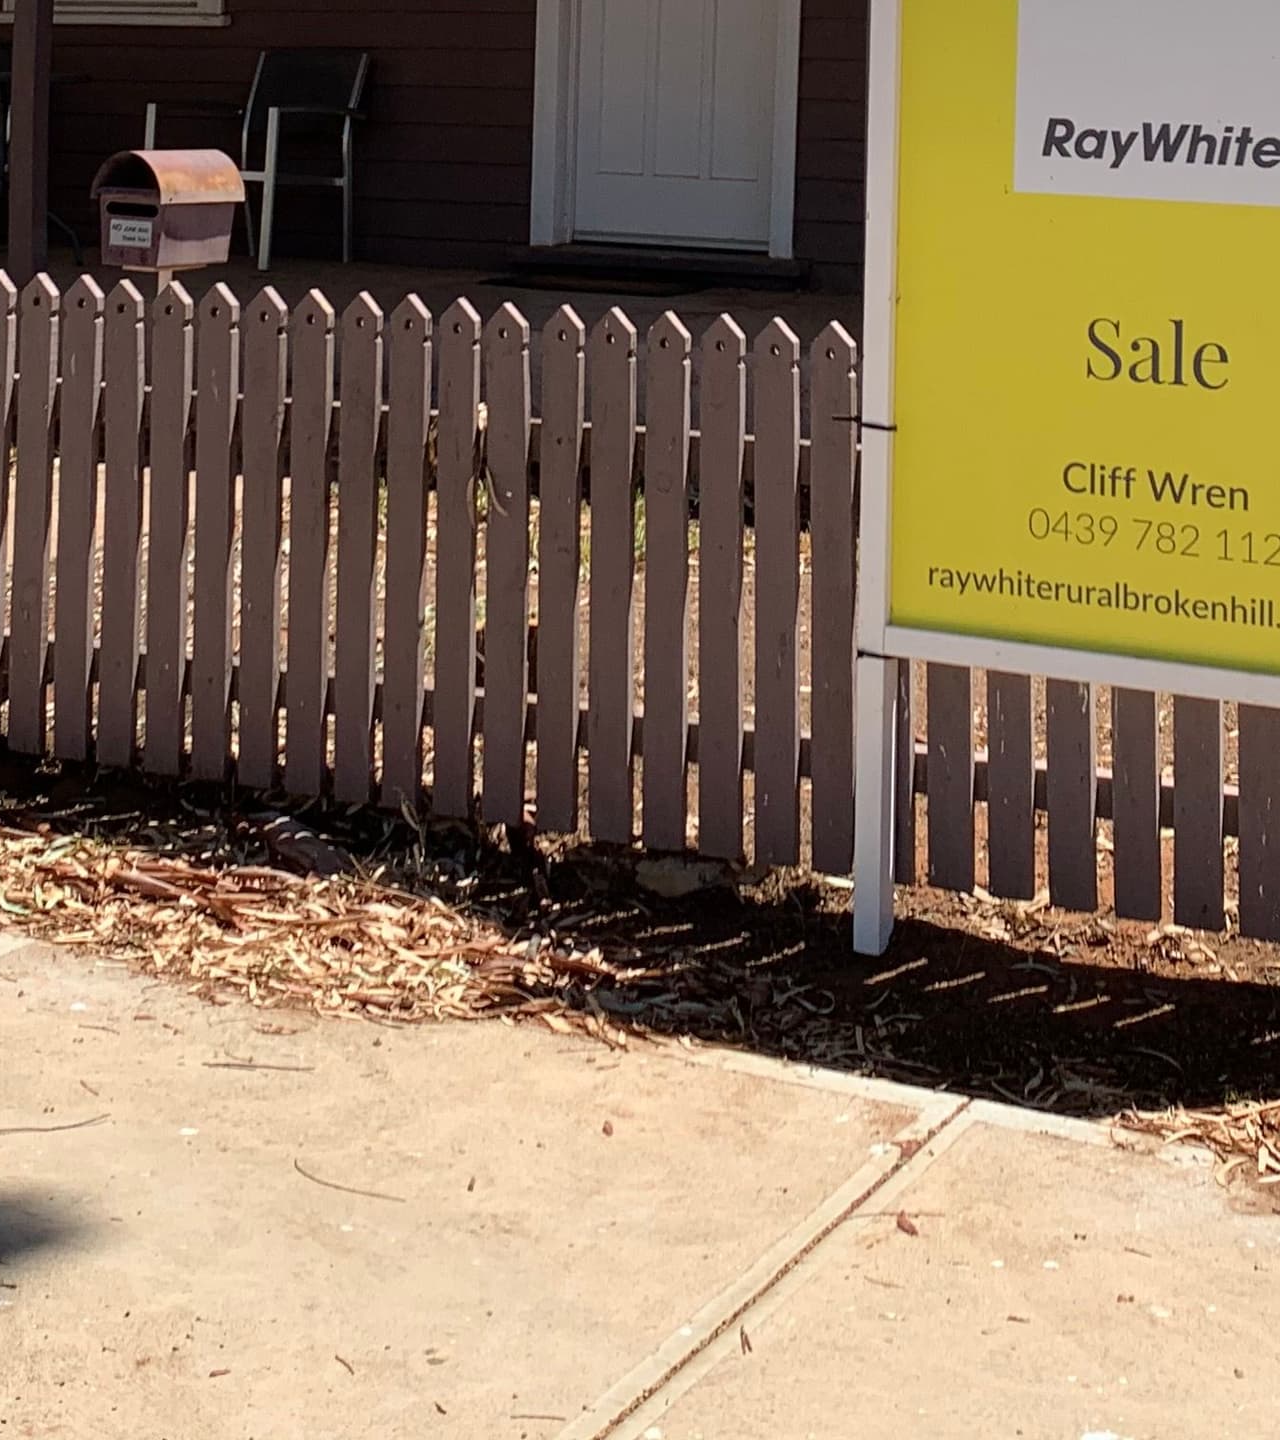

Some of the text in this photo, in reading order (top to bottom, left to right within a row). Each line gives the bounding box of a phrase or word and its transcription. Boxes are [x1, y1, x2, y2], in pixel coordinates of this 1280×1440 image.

[1086, 318, 1229, 391] Sale
[1063, 462, 1249, 511] Cliff Wren
[1028, 507, 1118, 547] 0439
[1132, 519, 1200, 558] 782
